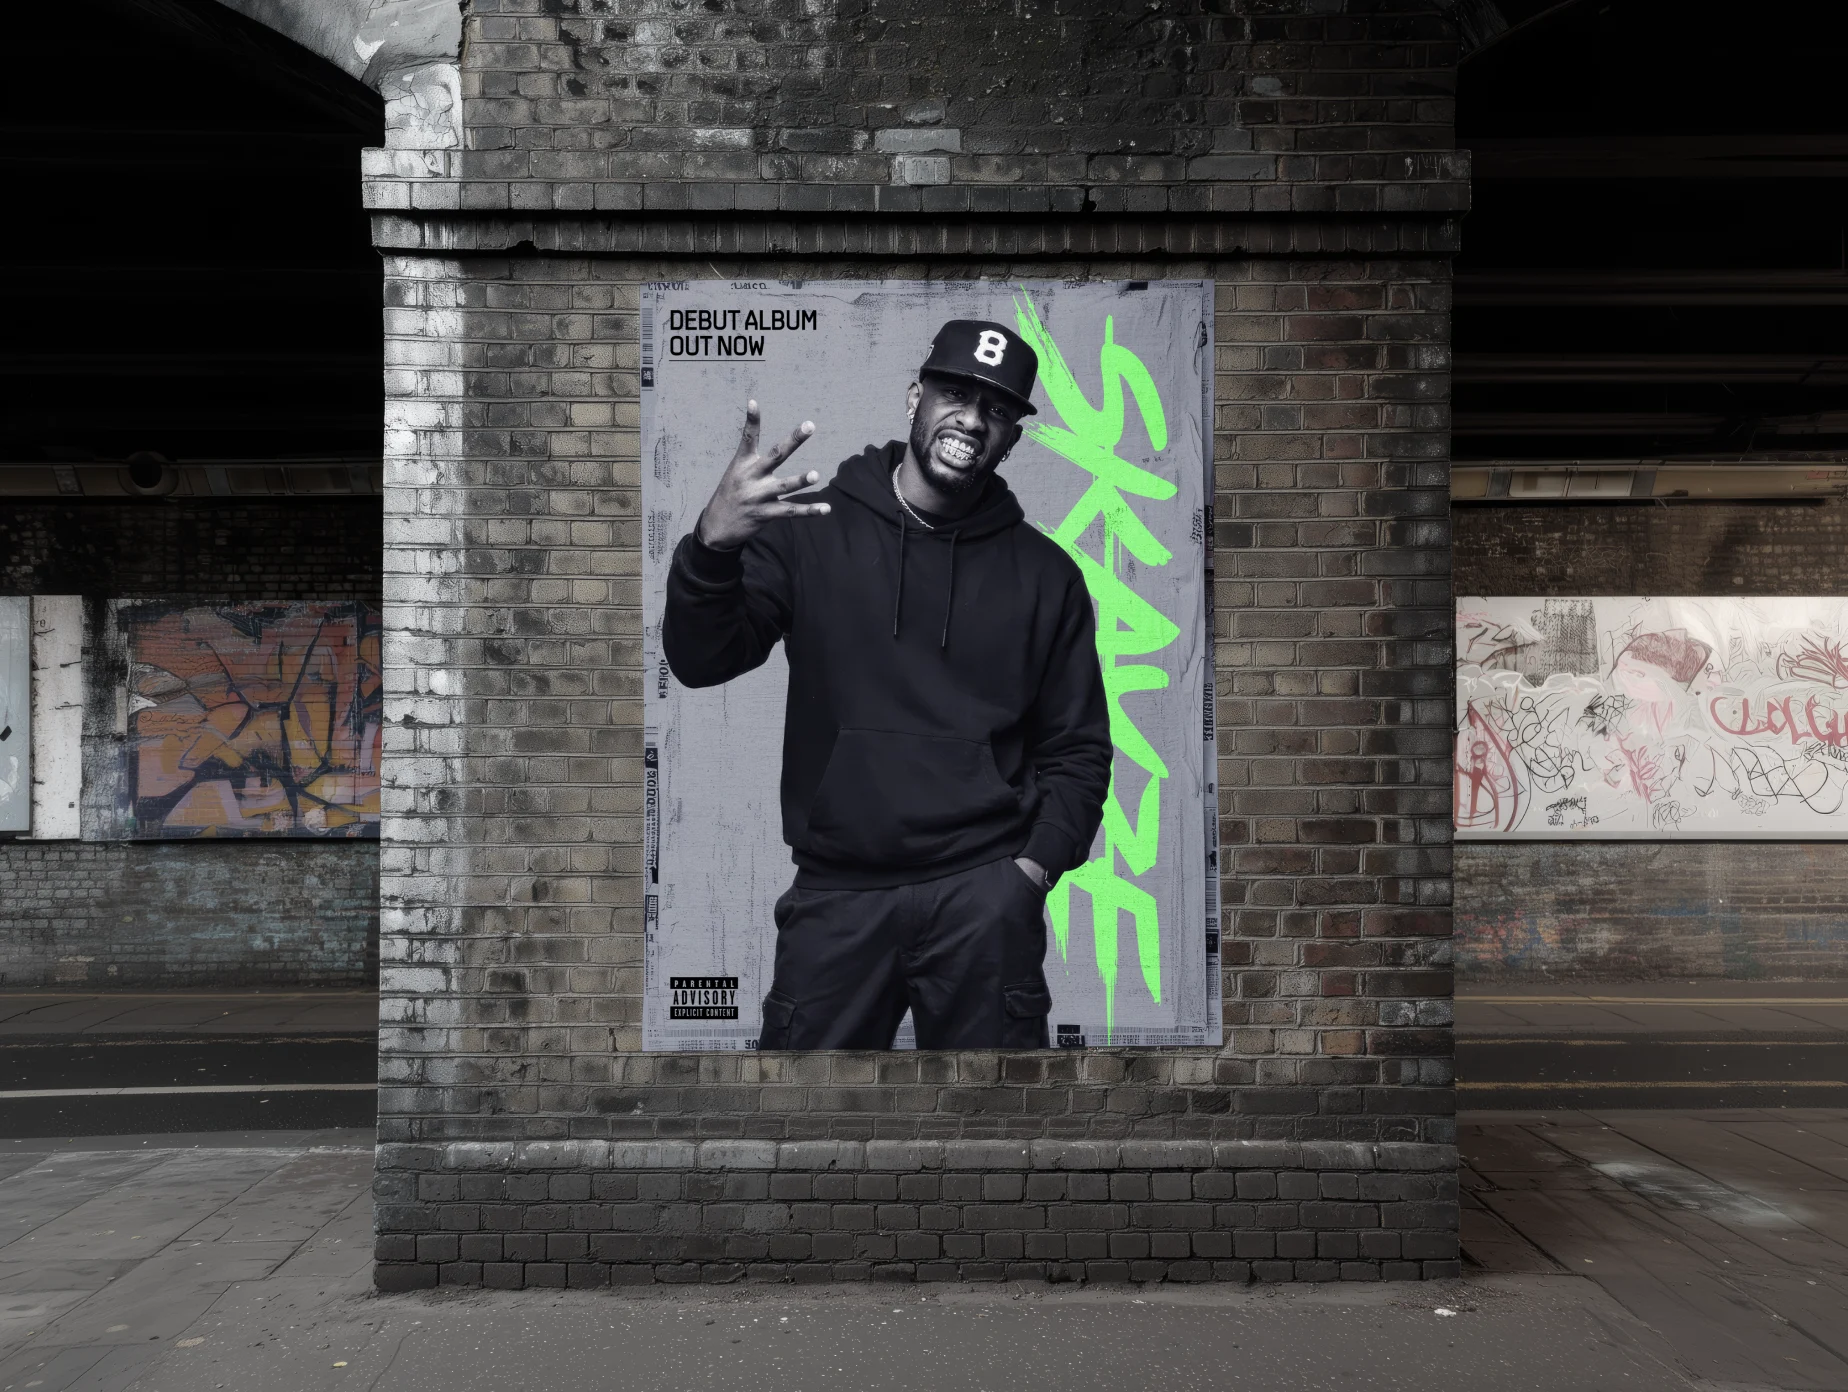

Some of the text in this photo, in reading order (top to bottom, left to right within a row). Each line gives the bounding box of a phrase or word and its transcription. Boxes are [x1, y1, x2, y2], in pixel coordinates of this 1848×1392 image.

[670, 309, 817, 331] DEBUT ALBUM
[669, 335, 765, 356] OUT NOW
[973, 329, 1008, 367] 8
[674, 979, 735, 988] PARENTAL
[673, 990, 735, 1006] ADVISORY
[674, 1008, 735, 1017] EXPLICIT CONTENT
